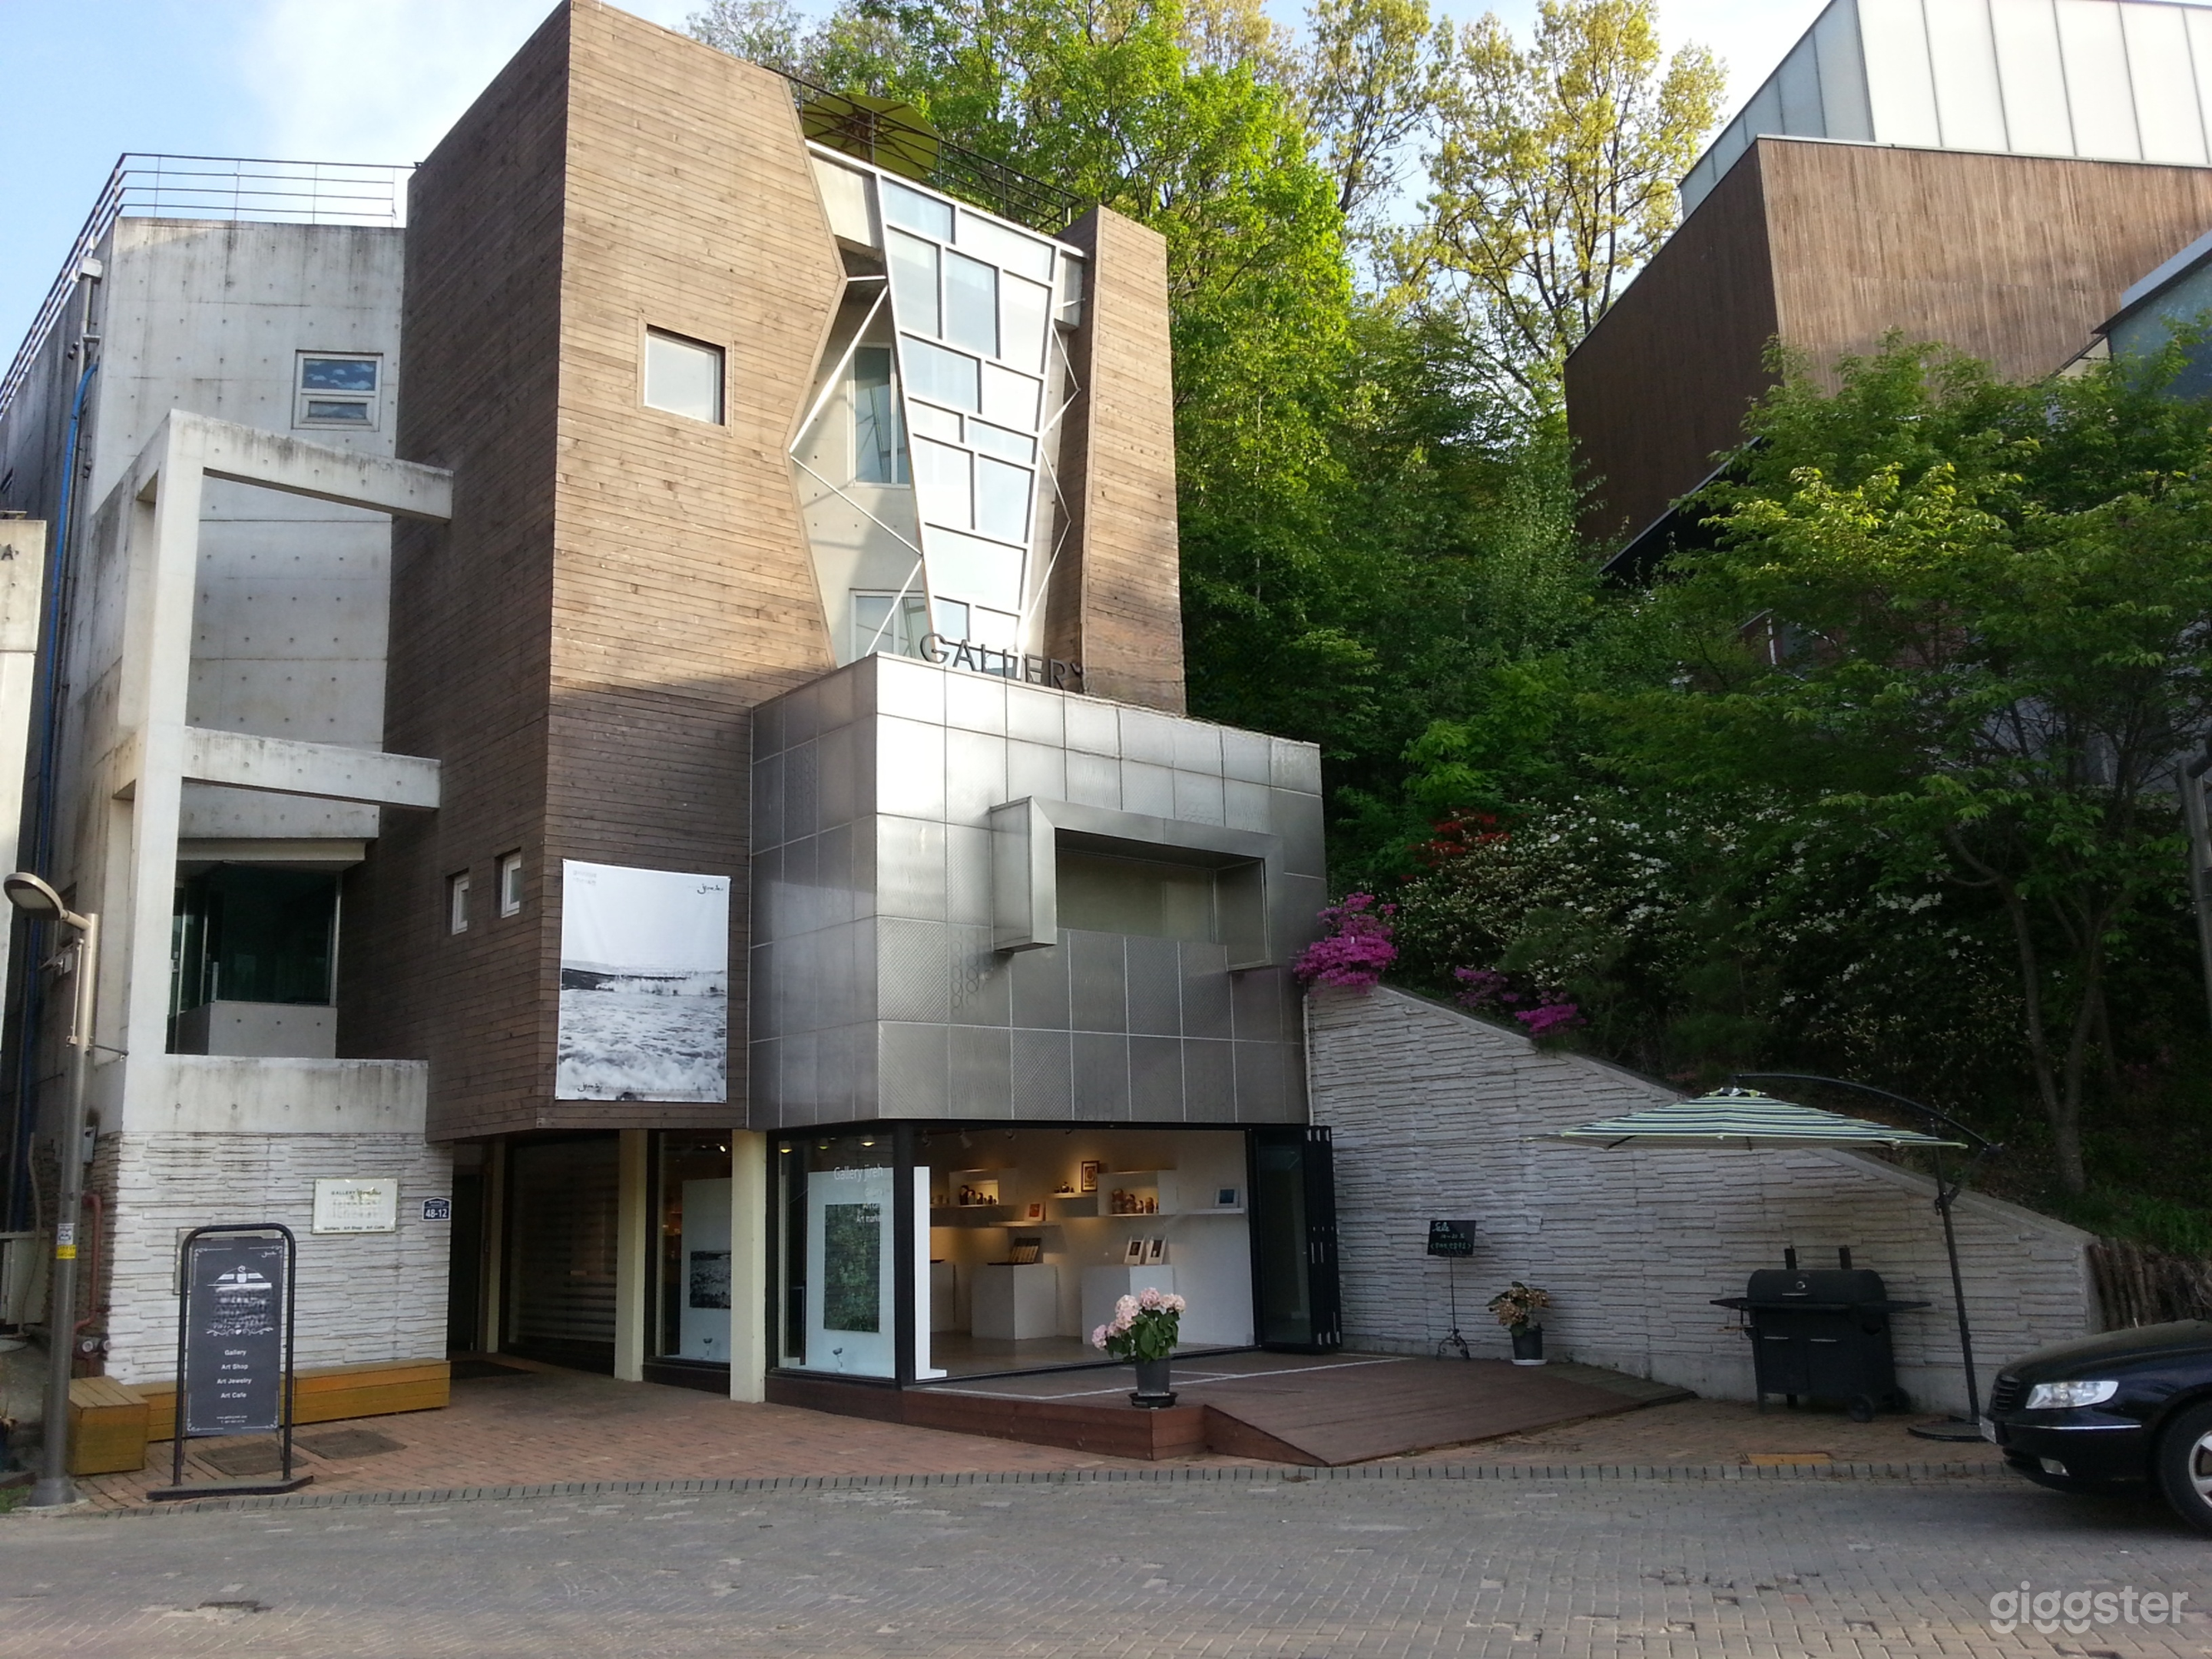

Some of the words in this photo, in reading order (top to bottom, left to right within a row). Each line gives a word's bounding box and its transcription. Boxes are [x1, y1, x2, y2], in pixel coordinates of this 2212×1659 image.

[920, 633, 1086, 694] GALLERY
[834, 1165, 862, 1182] Gallery
[426, 1208, 447, 1218] 48-12
